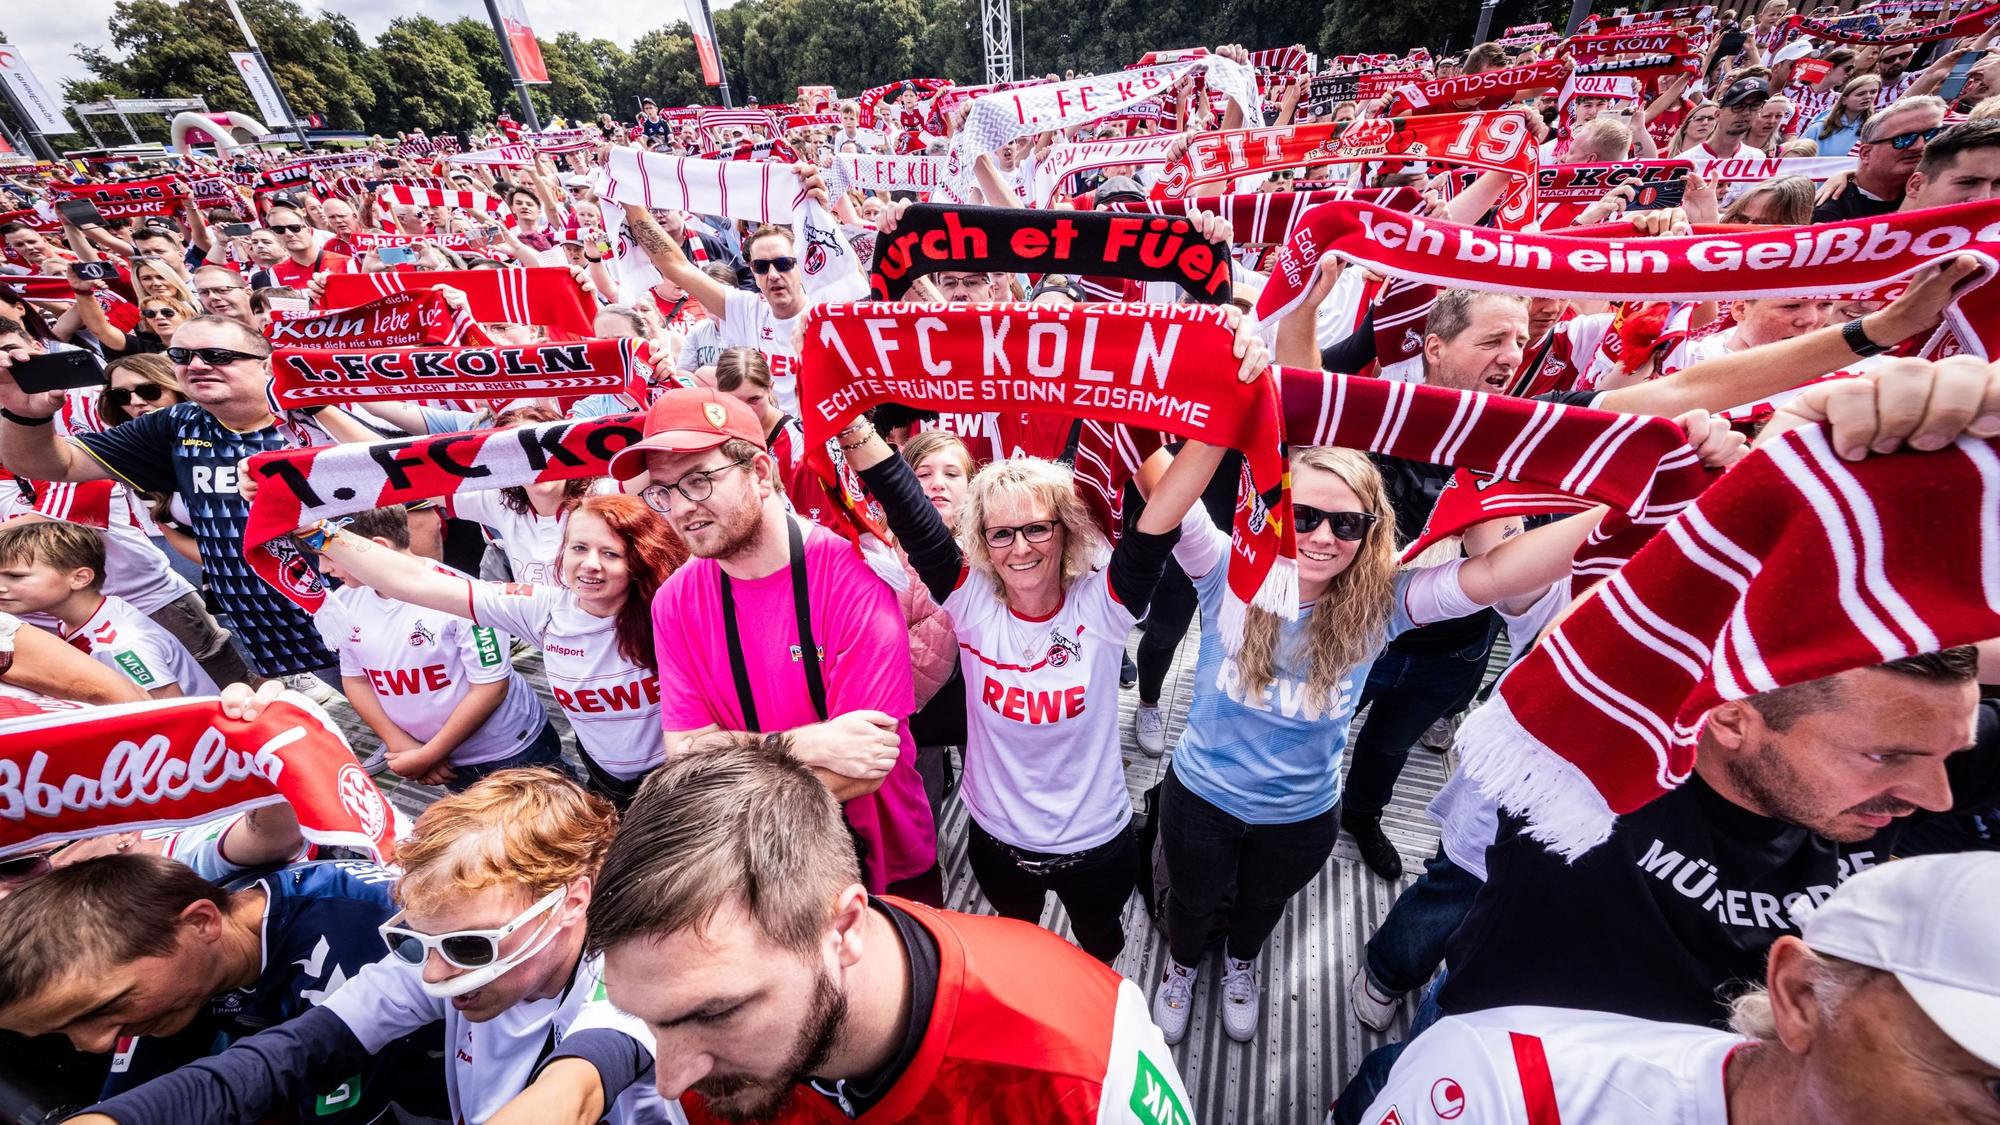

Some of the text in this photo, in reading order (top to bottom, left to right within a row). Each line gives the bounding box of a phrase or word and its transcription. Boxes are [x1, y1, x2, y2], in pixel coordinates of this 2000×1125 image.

[1570, 36, 1671, 54] 1. FC KÖLN
[1575, 55, 1672, 74] MVEREIN
[1013, 95, 1037, 124] 1.
[1056, 87, 1098, 117] FC
[501, 145, 532, 164] ÖLN
[1155, 125, 1296, 198] SEIT
[876, 160, 896, 176] FC
[908, 157, 938, 186] KÖL
[126, 186, 163, 201] FC
[1540, 189, 1578, 197] MACHT
[1010, 220, 1078, 260] et
[1294, 227, 1317, 269] Eddy
[1359, 210, 1445, 256] Ich
[1456, 228, 1552, 271] bin
[1567, 241, 1670, 274] ein
[374, 309, 410, 334] lebe
[1082, 302, 1229, 327] ZOSAMM
[324, 339, 347, 349] dich
[350, 339, 366, 348] nie
[387, 332, 420, 345] Stich!
[979, 311, 1183, 390] KÖLN
[412, 344, 594, 378] KÖLN
[376, 380, 526, 395] DIE MACHT AM RHEIN
[816, 379, 1212, 428] ECHTE FRÜNDE STONN ZOSAMME
[259, 415, 643, 509] 1. FC KÖ
[192, 465, 240, 494] RE
[476, 626, 499, 663] DEVK
[545, 642, 585, 658] uhlsport
[120, 654, 151, 682] DEVK
[555, 675, 662, 714] REWE
[983, 674, 1086, 725] REWE
[0, 725, 308, 822] ßballclub
